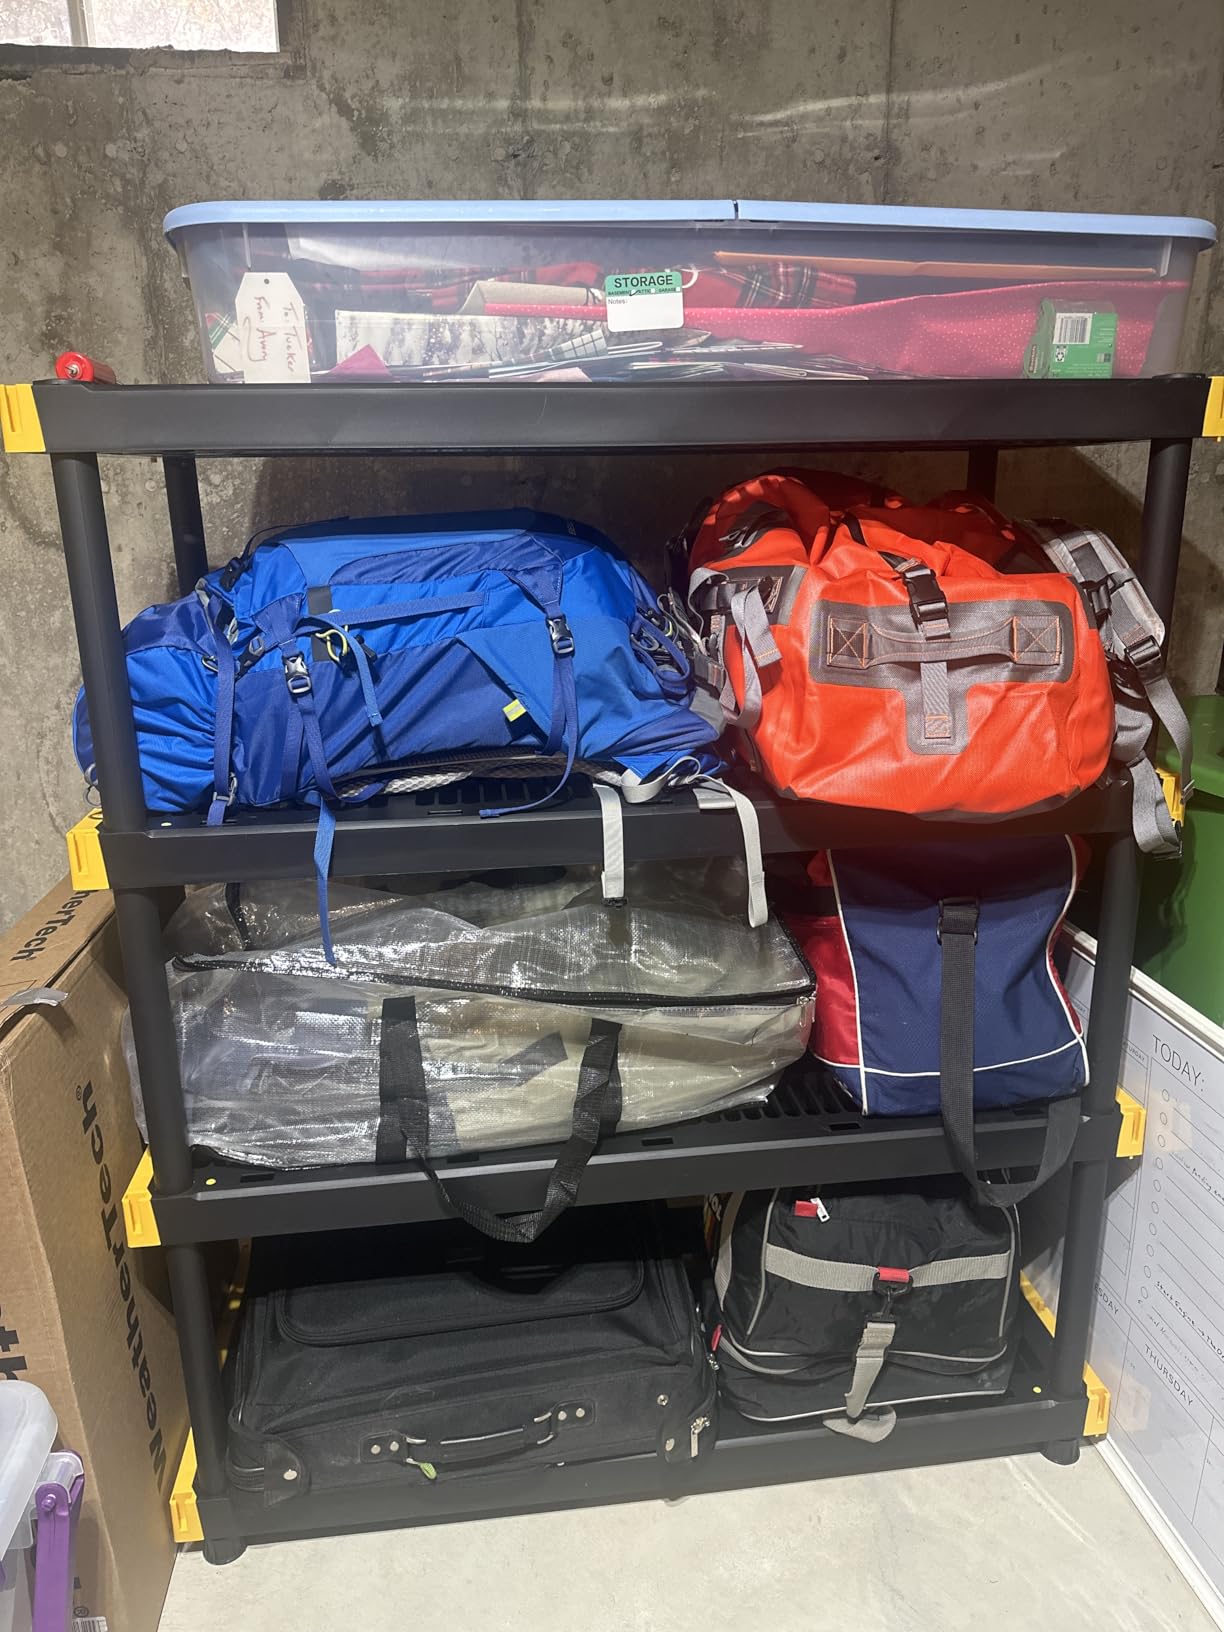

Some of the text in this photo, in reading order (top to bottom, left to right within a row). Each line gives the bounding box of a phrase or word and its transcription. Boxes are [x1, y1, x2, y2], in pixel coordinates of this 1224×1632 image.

[614, 275, 673, 288] STORAGE
[10, 889, 98, 961] herTech
[1152, 1034, 1205, 1092] TODAY:
[82, 1080, 166, 1496] WeatherTech
[1144, 1343, 1194, 1406] THURSDAY
